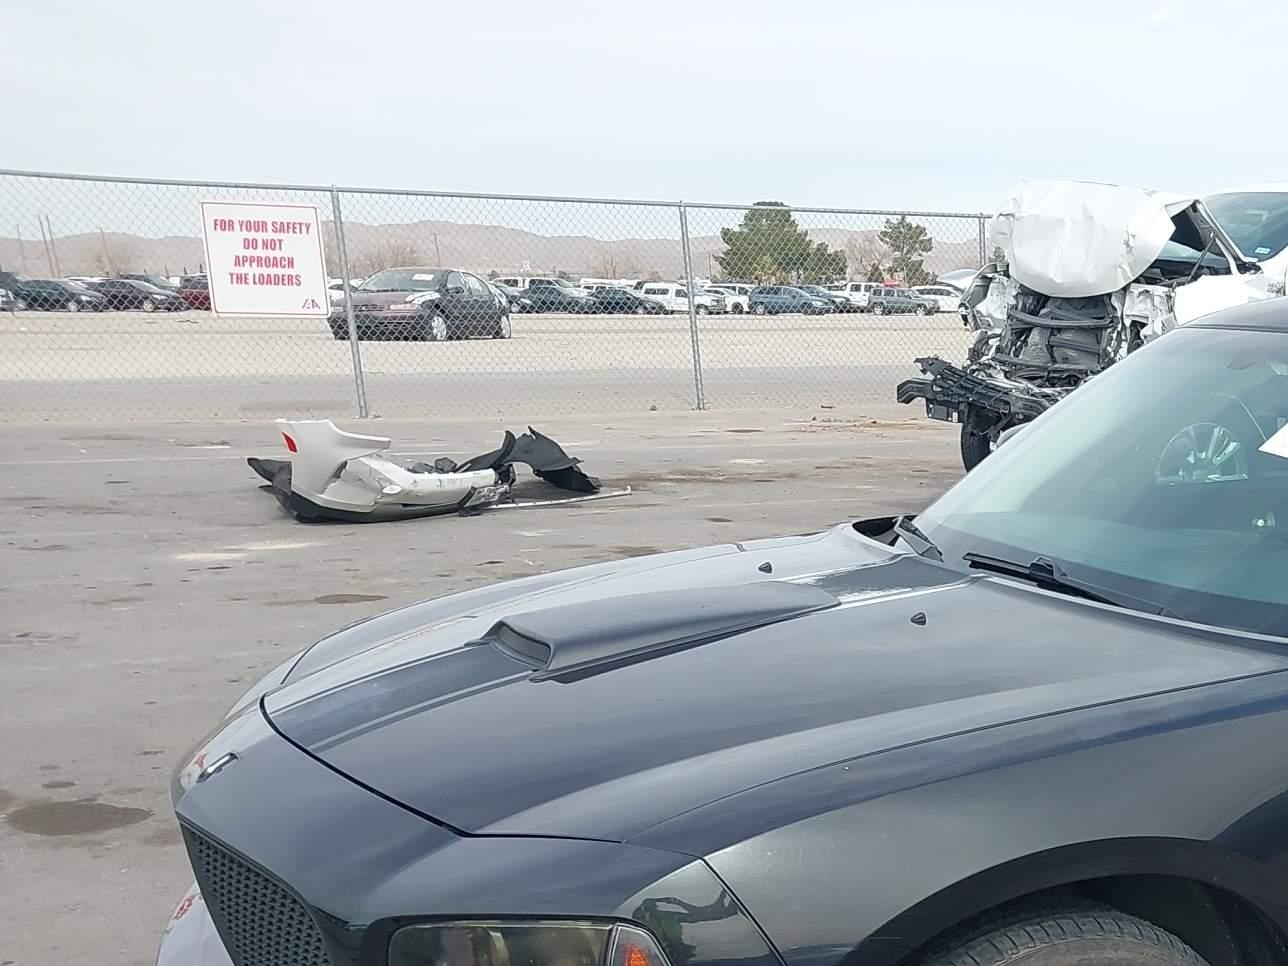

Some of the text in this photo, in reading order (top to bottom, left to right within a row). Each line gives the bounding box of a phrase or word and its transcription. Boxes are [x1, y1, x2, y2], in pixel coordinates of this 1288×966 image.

[213, 219, 311, 235] FOR YOUR SAFETY
[243, 238, 284, 251] DO NOT
[234, 255, 294, 269] APPROACH
[229, 272, 302, 286] THE LOADERS
